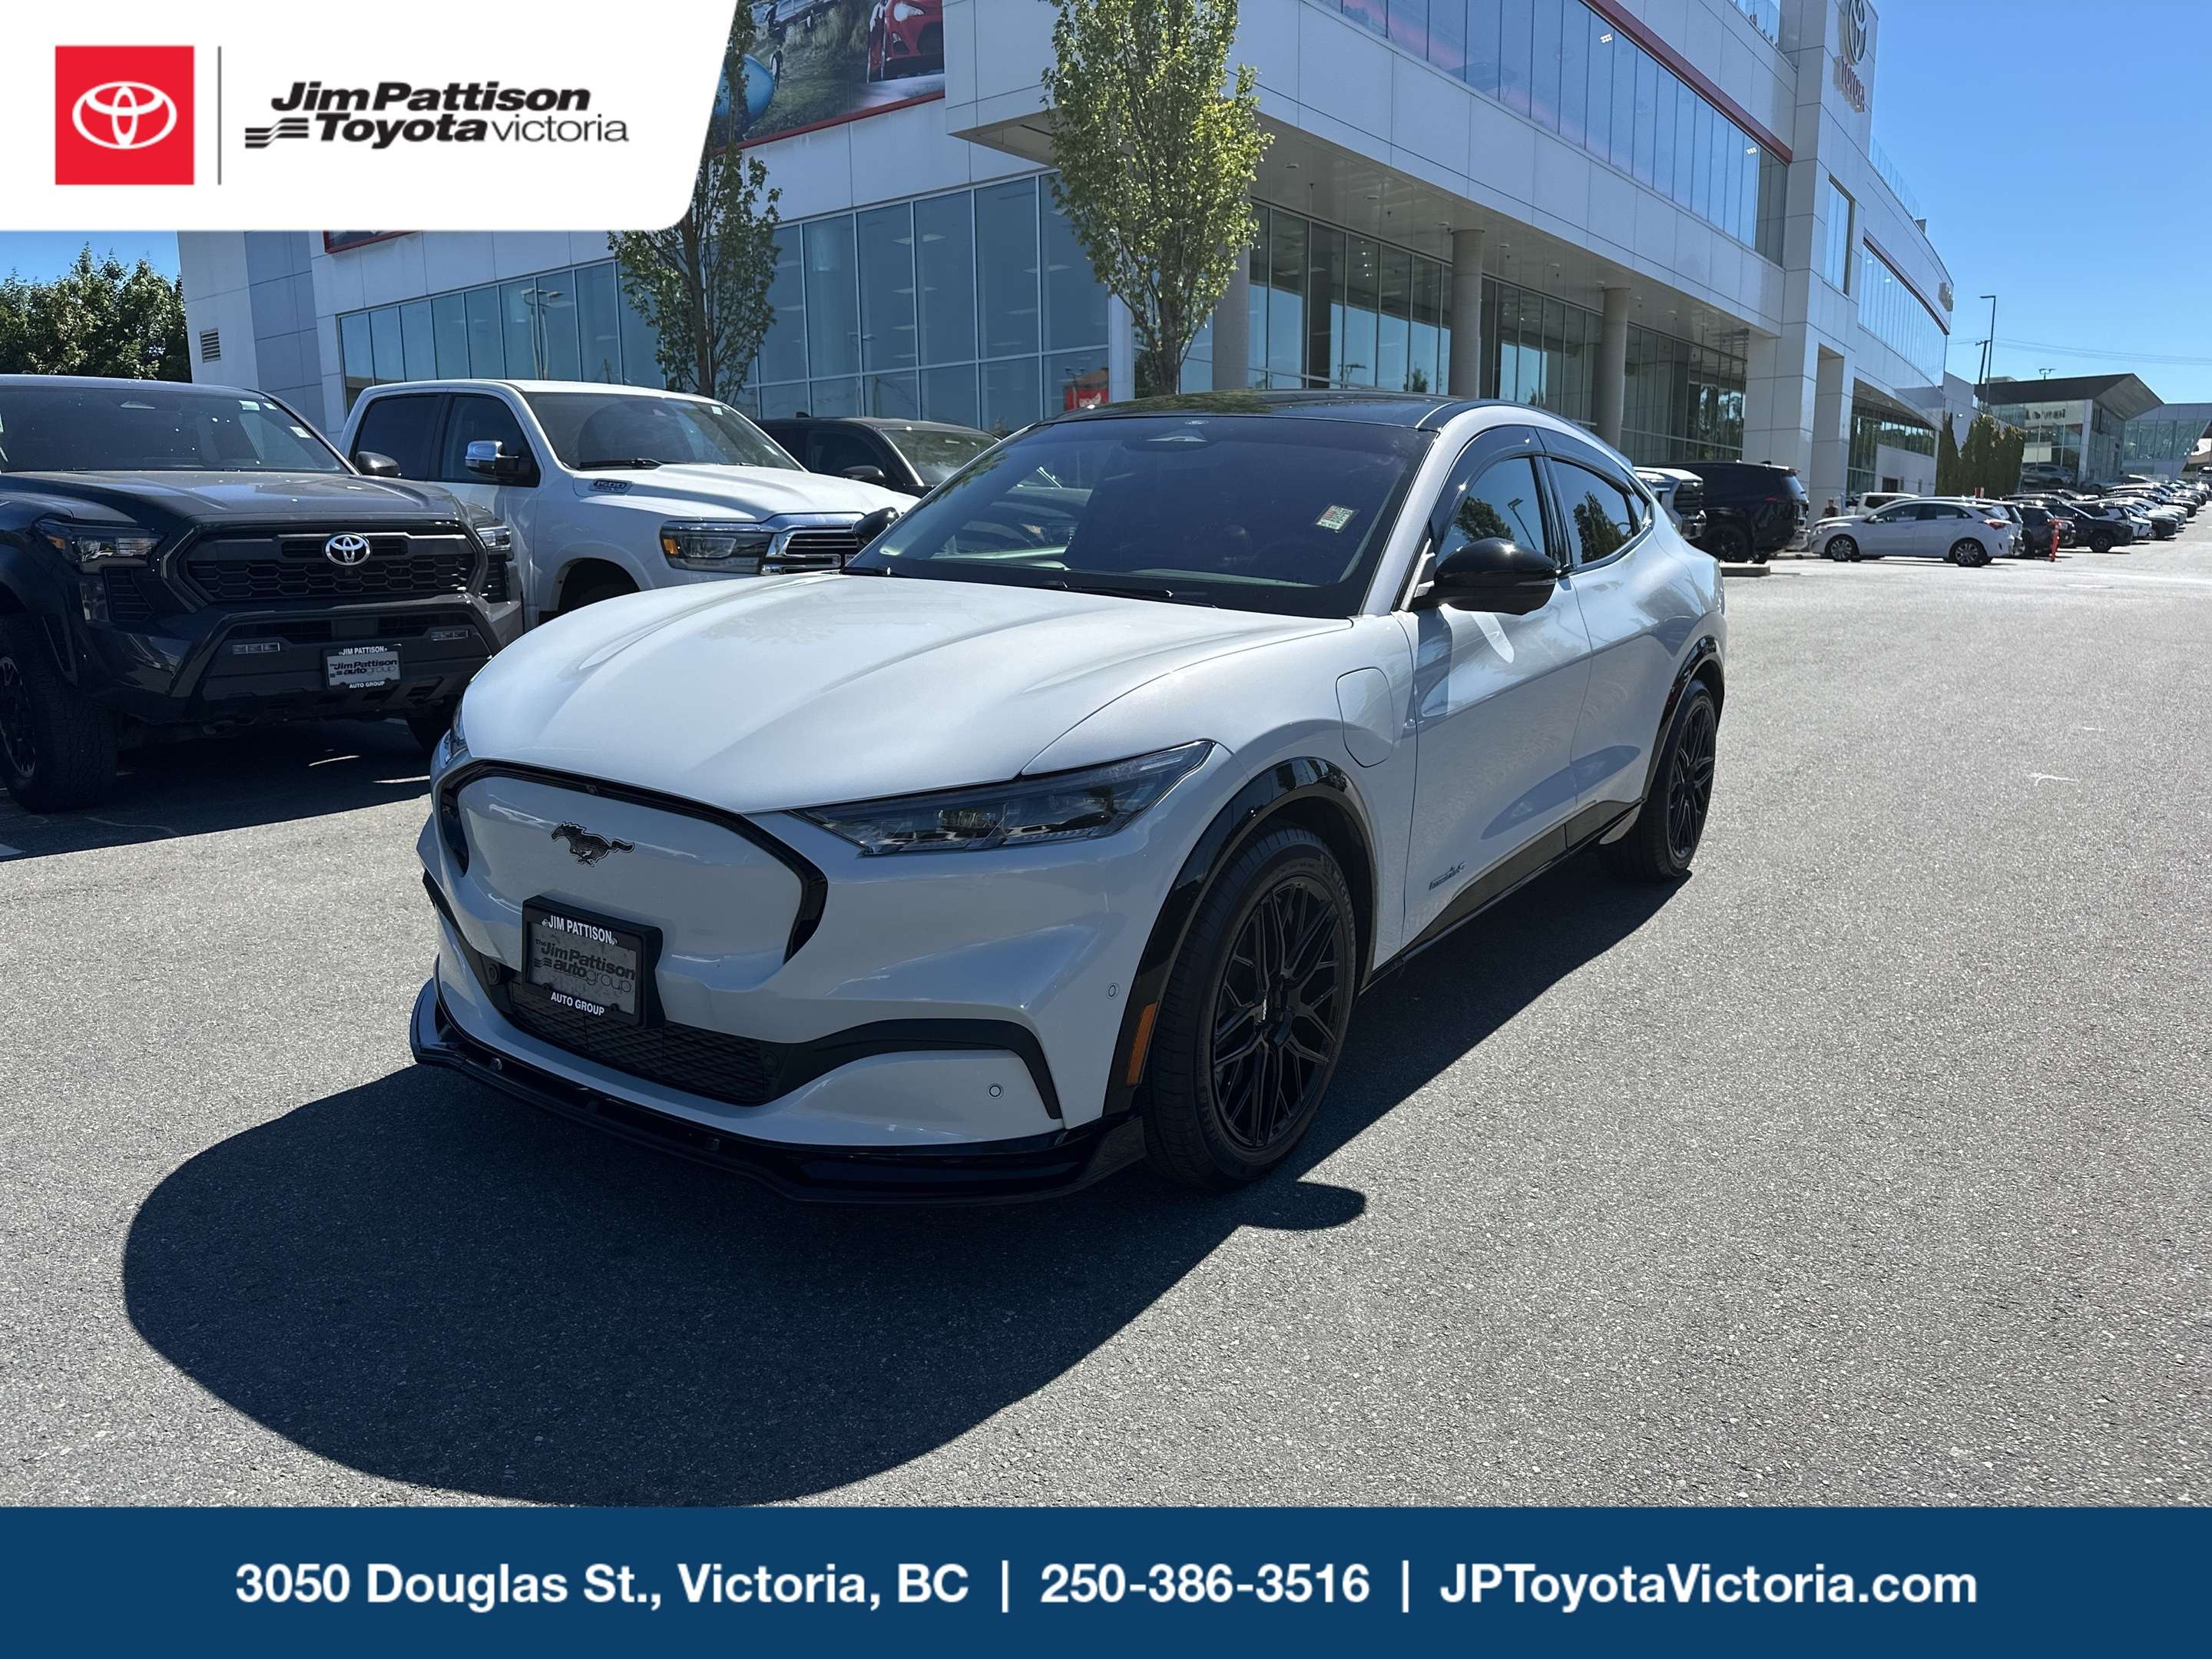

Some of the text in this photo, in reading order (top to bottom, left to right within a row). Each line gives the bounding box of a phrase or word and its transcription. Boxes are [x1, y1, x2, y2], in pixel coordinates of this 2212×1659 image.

[342, 645, 385, 656] JIM PATTISON
[334, 660, 398, 671] Jim Pattison
[548, 915, 613, 945] JIM PATTISON
[541, 942, 636, 981] Jim Pattison
[552, 959, 633, 995] auto group
[551, 992, 605, 1017] AUTO GROUP
